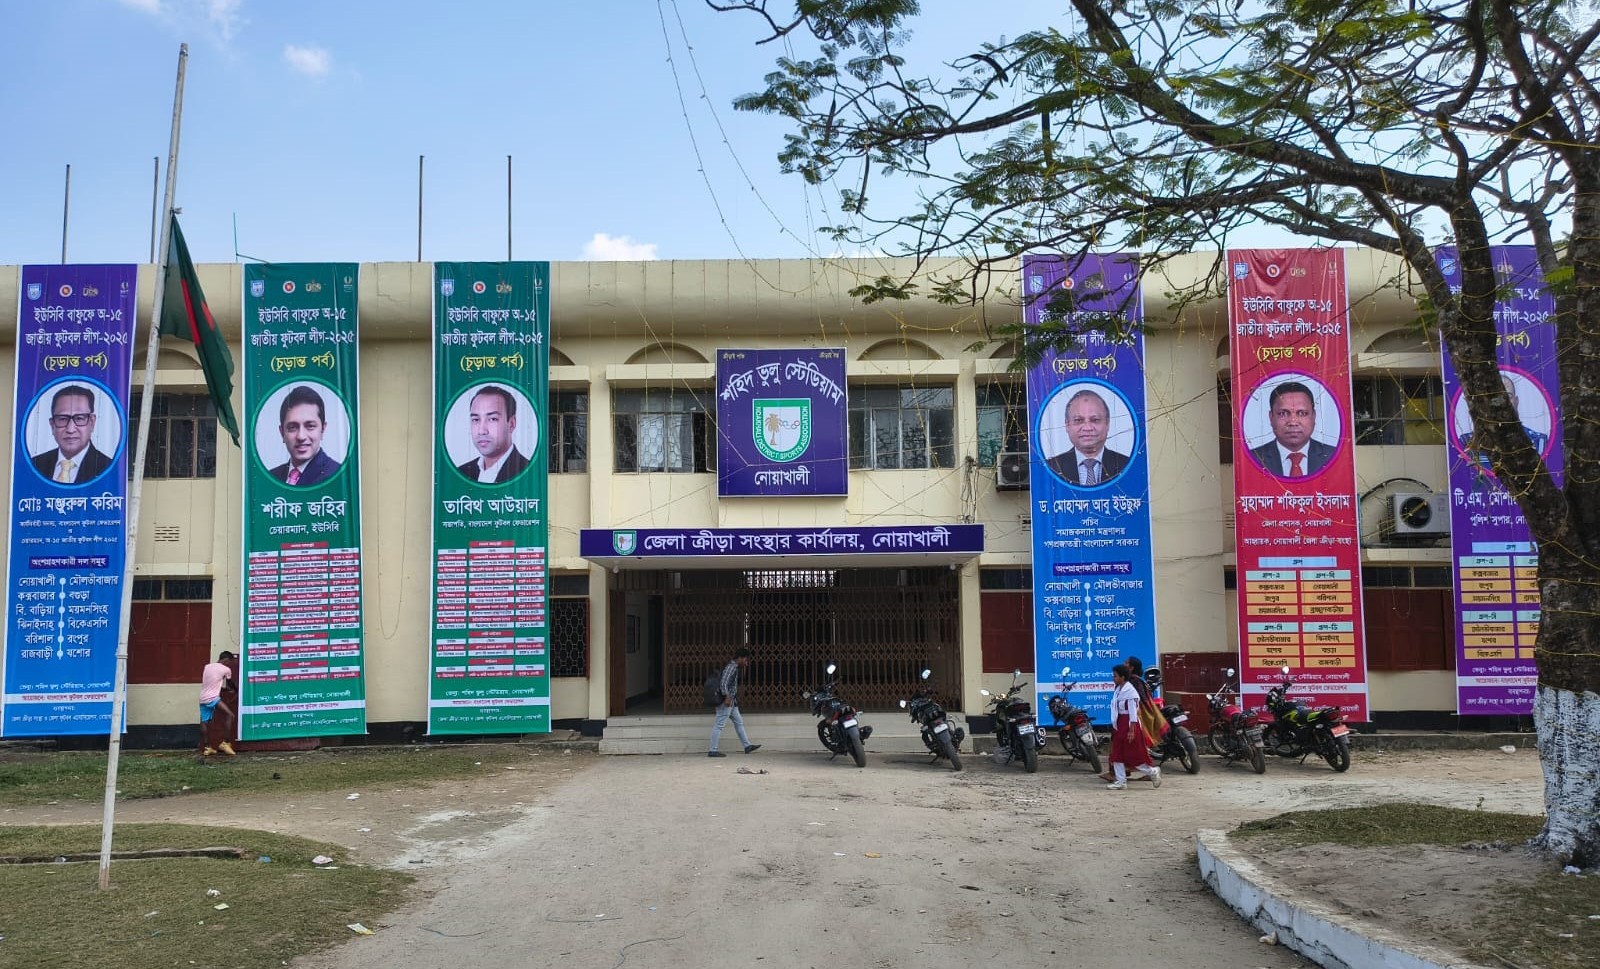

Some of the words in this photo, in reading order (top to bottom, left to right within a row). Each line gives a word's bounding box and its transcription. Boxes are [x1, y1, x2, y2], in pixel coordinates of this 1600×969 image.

[1242, 296, 1274, 314] ইউসিবি
[1277, 299, 1305, 316] বাফুফে
[1307, 299, 1333, 312] অ-১৫
[1503, 306, 1549, 324] লীগ-২০২৫
[34, 306, 65, 323] ইউসিবি
[67, 309, 95, 325] বাফুফে
[98, 308, 122, 321] অ-১৫
[258, 306, 289, 324] ইউসিবি
[292, 308, 320, 325] বাফুফে
[322, 308, 346, 320] অ-১৫
[448, 306, 479, 323] ইউসিবি
[481, 308, 510, 325] বাফুফে
[512, 309, 536, 321] অ-১৫
[1236, 319, 1263, 337] জাতীয়
[1266, 320, 1293, 339] ফুটবল
[1295, 318, 1341, 337] লীগ-২০২৫
[25, 328, 52, 345] জাতীয়
[54, 330, 81, 349] ফুটবল
[83, 327, 128, 345] লীগ-২০২৫
[251, 329, 278, 347] জাতীয়
[280, 330, 306, 349] ফুটবল
[309, 327, 355, 344] লীগ-২০২৫
[441, 328, 468, 346] জাতীয়
[470, 330, 496, 349] ফুটবল
[498, 327, 543, 345] লীগ-২০২৫
[1506, 330, 1530, 350] পর্ব)
[1298, 342, 1322, 360] পর্ব)
[85, 352, 108, 370] পর্ব)
[312, 351, 335, 370] পর্ব)
[501, 352, 524, 370] পর্ব)
[1093, 353, 1116, 373] পর্ব)
[720, 370, 754, 400] শহিদ
[756, 362, 781, 387] ভুলু
[785, 357, 844, 406] স্টেডিয়াম
[754, 465, 811, 486] নোয়াখালী
[18, 496, 42, 512] মোঃ
[91, 492, 124, 511] করিম
[261, 497, 302, 519] শরীফ
[306, 496, 347, 518] জহির
[442, 495, 484, 515] তাবিথ
[487, 494, 540, 514] আউয়াল
[1053, 499, 1090, 515] মোহাম্মদ
[1092, 499, 1111, 515] আবু
[1240, 494, 1274, 515] মুহাম্মদ
[1276, 490, 1314, 514] শফিকুল
[1316, 492, 1350, 512] ইসলাম
[644, 533, 687, 550] জেলা
[690, 530, 735, 553] ক্রীড়া
[738, 533, 792, 553] সংস্থার
[796, 528, 865, 550] কার্যালয়,
[872, 526, 952, 548] নোয়াখালী
[18, 574, 55, 587] নোয়াখালী
[70, 573, 118, 586] মৌলভীবাজার
[1044, 579, 1081, 592] নোয়াখালী
[1093, 578, 1144, 590] মৌলভীবাজার
[68, 590, 90, 601] বগুড়া
[1094, 594, 1116, 604] বগুড়া
[30, 603, 55, 616] বাড়িয়া
[68, 602, 109, 614] ময়মনসিংহ
[1094, 606, 1136, 618] ময়মনসিংহ
[68, 617, 108, 630] বিকেএসপি
[1095, 619, 1136, 632] বিকেএসপি
[25, 632, 54, 644] বরিশাল
[67, 634, 88, 645] রংপুর
[1055, 635, 1083, 646] বরিশাল
[1096, 636, 1118, 646] রংপুর
[21, 646, 54, 660] রাজবাড়ী
[66, 648, 91, 658] যশোর
[1052, 647, 1084, 660] রাজবাড়ী
[1096, 649, 1120, 659] যশোর
